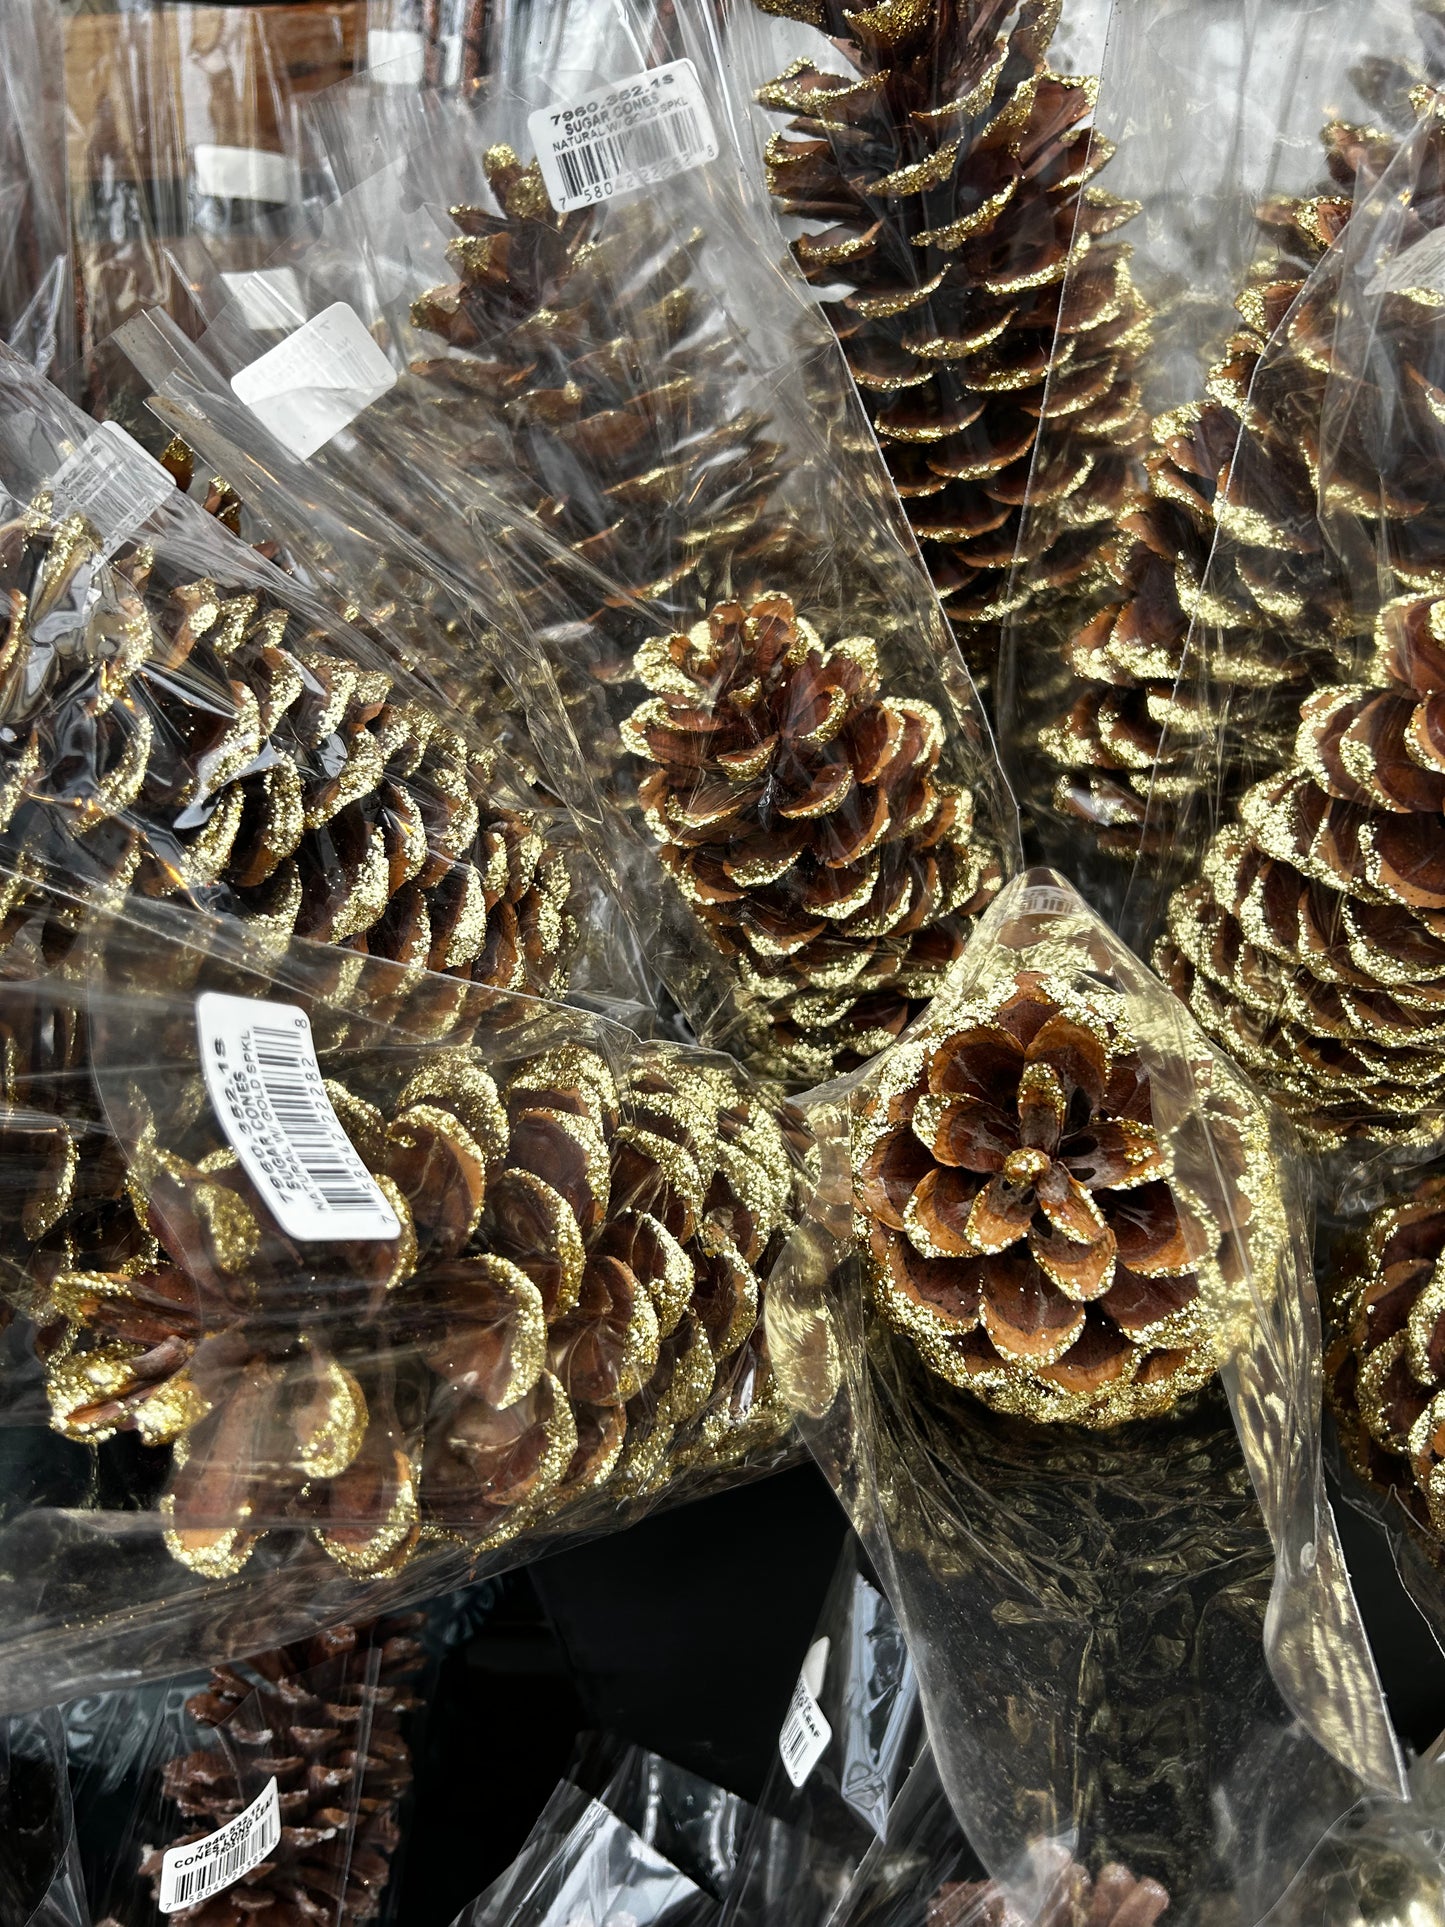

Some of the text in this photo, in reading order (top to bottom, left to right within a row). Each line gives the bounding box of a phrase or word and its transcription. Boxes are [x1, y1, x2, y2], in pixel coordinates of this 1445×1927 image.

[552, 125, 606, 152] NATURAL
[660, 96, 689, 113] SPKL
[565, 91, 660, 136] SUGAR CONES
[240, 1030, 257, 1074] SPKL
[249, 1079, 273, 1122] GOLD
[301, 1057, 336, 1125] 22282
[232, 1071, 301, 1191] SUGAR CONES
[286, 1146, 329, 1212] NATURAL
[331, 1132, 378, 1191] 58042
[174, 1843, 220, 1869] CONES
[223, 1818, 253, 1847] LONG
[188, 1878, 228, 1904] 58042
